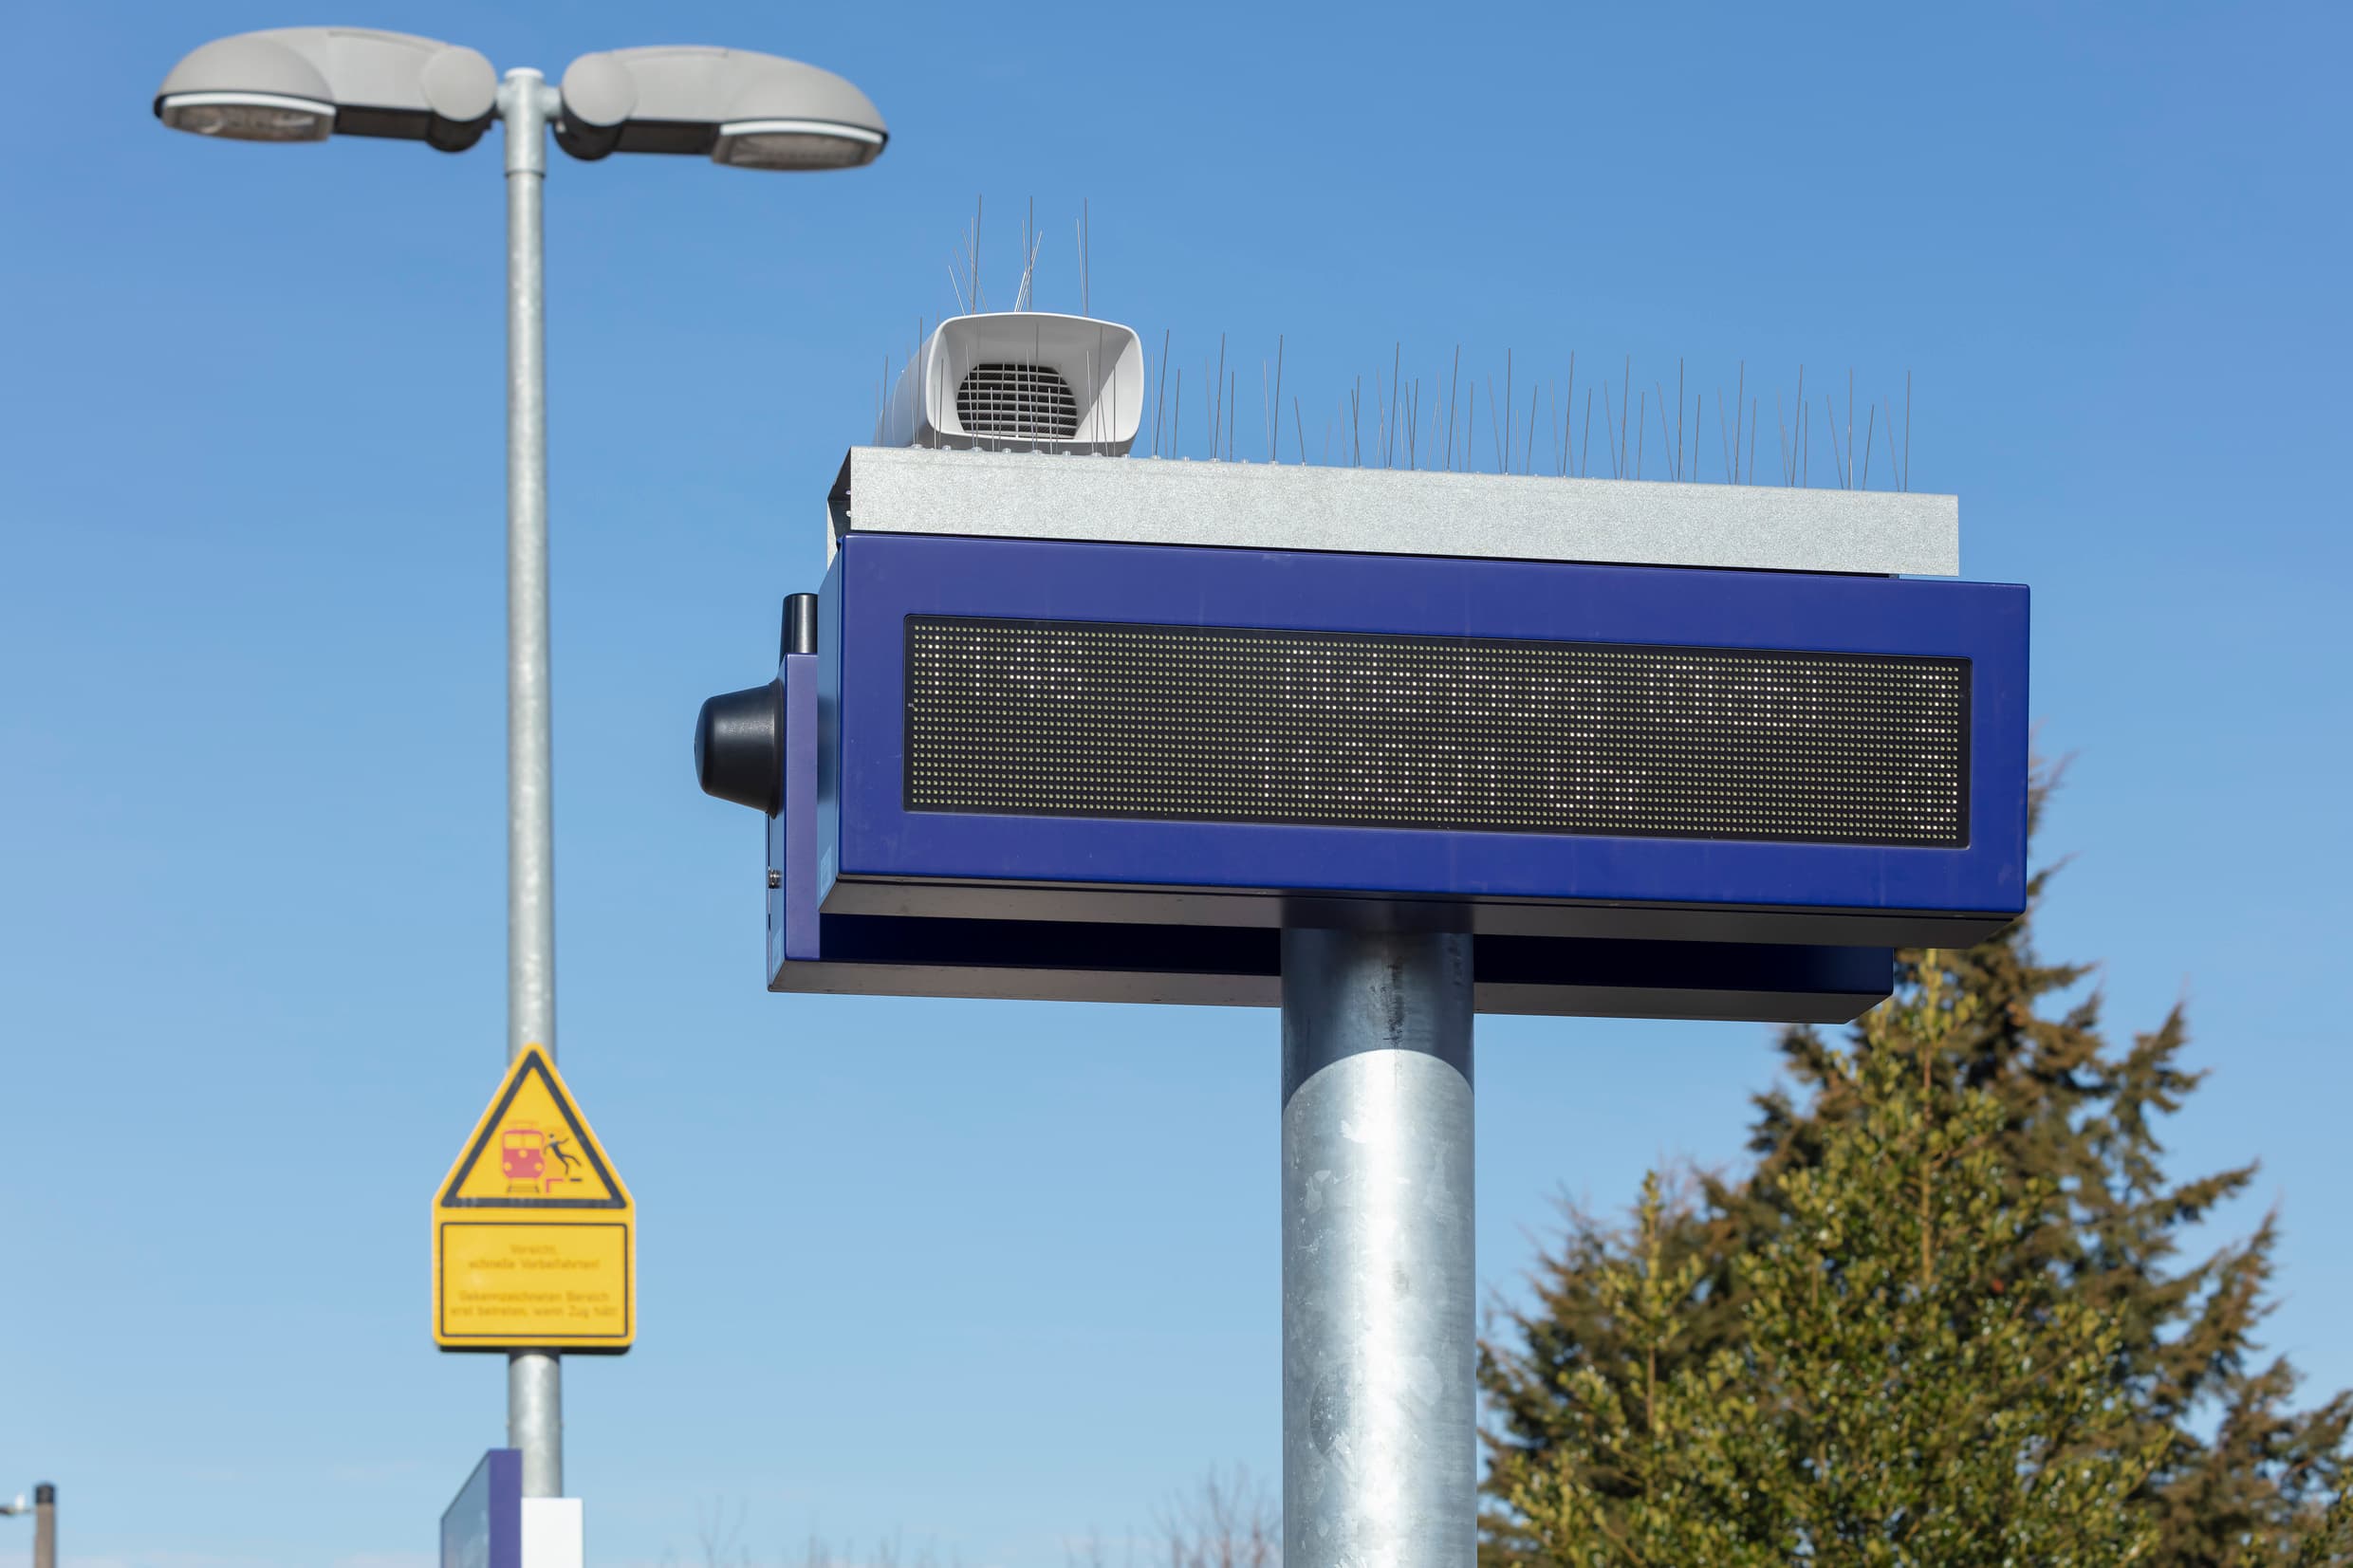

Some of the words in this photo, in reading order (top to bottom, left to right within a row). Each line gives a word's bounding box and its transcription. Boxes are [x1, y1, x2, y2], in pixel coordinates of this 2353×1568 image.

[920, 635, 1083, 700] 11:46
[1285, 649, 1602, 738] Oldenburg
[1648, 663, 1817, 729] (Oldb)
[1914, 674, 1946, 733] 2
[1251, 738, 1495, 805] 11:30:01
[1548, 748, 1646, 810] Uhr
